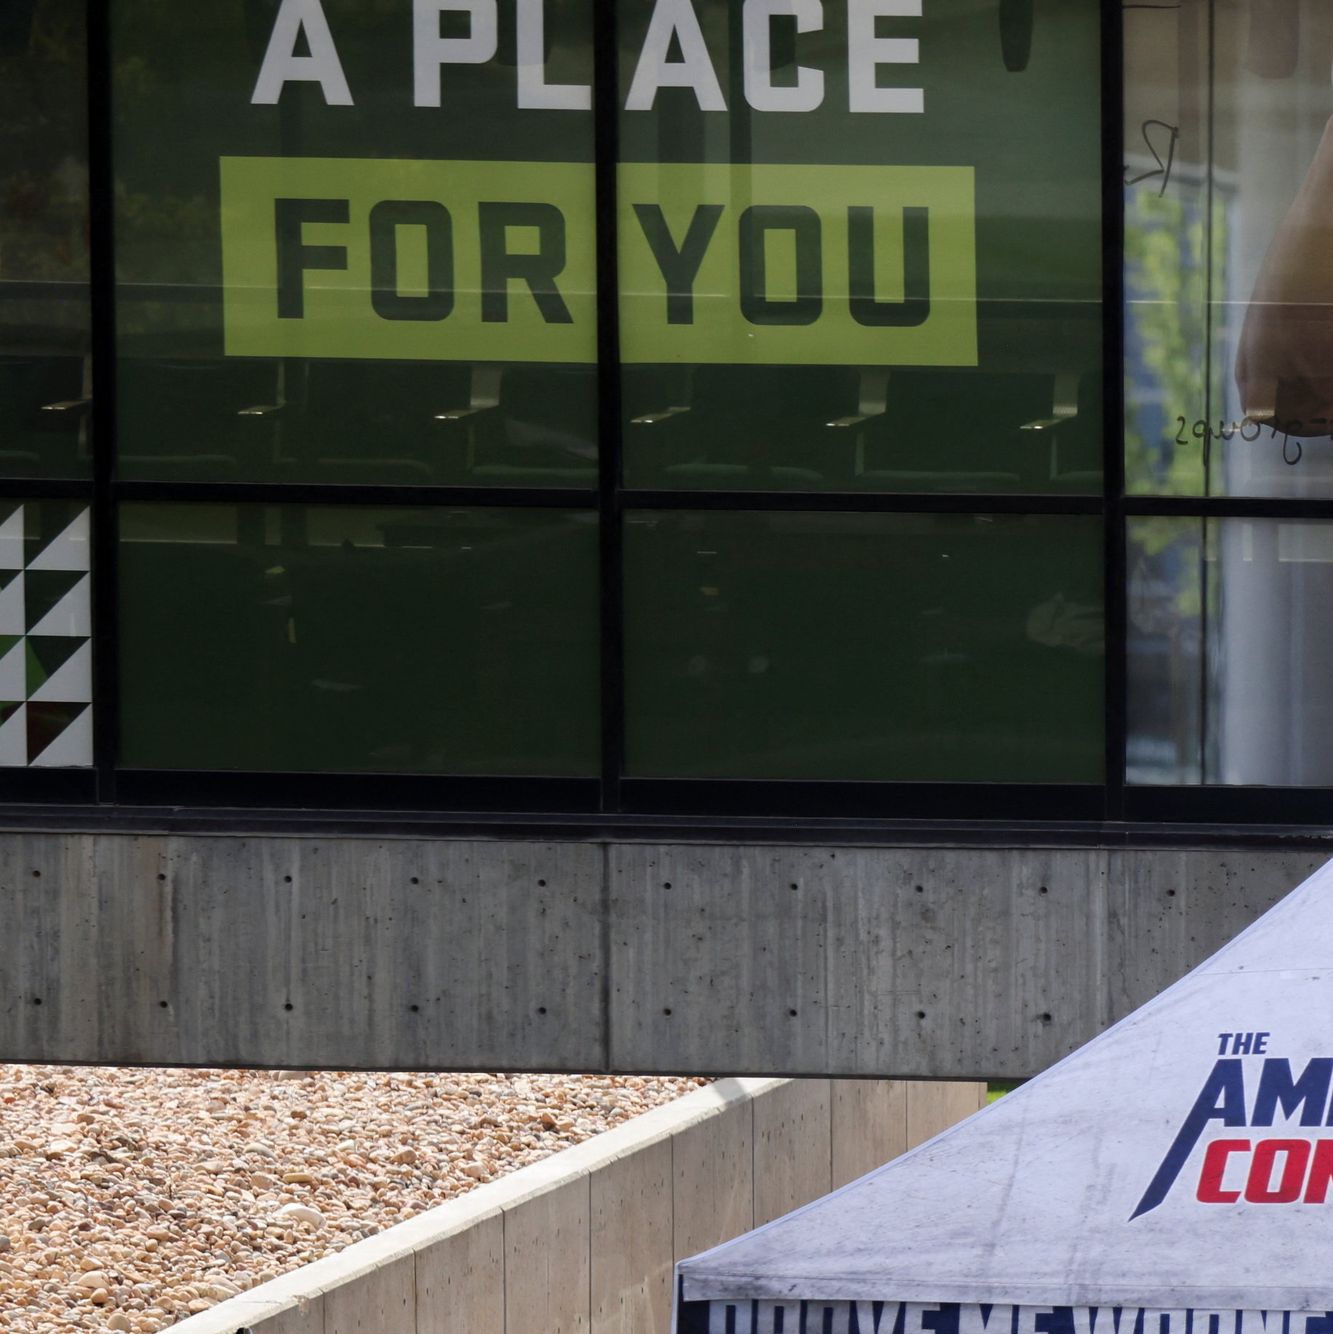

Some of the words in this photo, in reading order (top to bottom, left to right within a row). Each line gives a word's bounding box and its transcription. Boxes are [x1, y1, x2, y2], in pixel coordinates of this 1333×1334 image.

[250, 0, 354, 105] A
[412, 0, 925, 114] PLACE
[273, 197, 574, 324] FOR
[631, 203, 931, 328] YOU
[1217, 1032, 1270, 1055] THE
